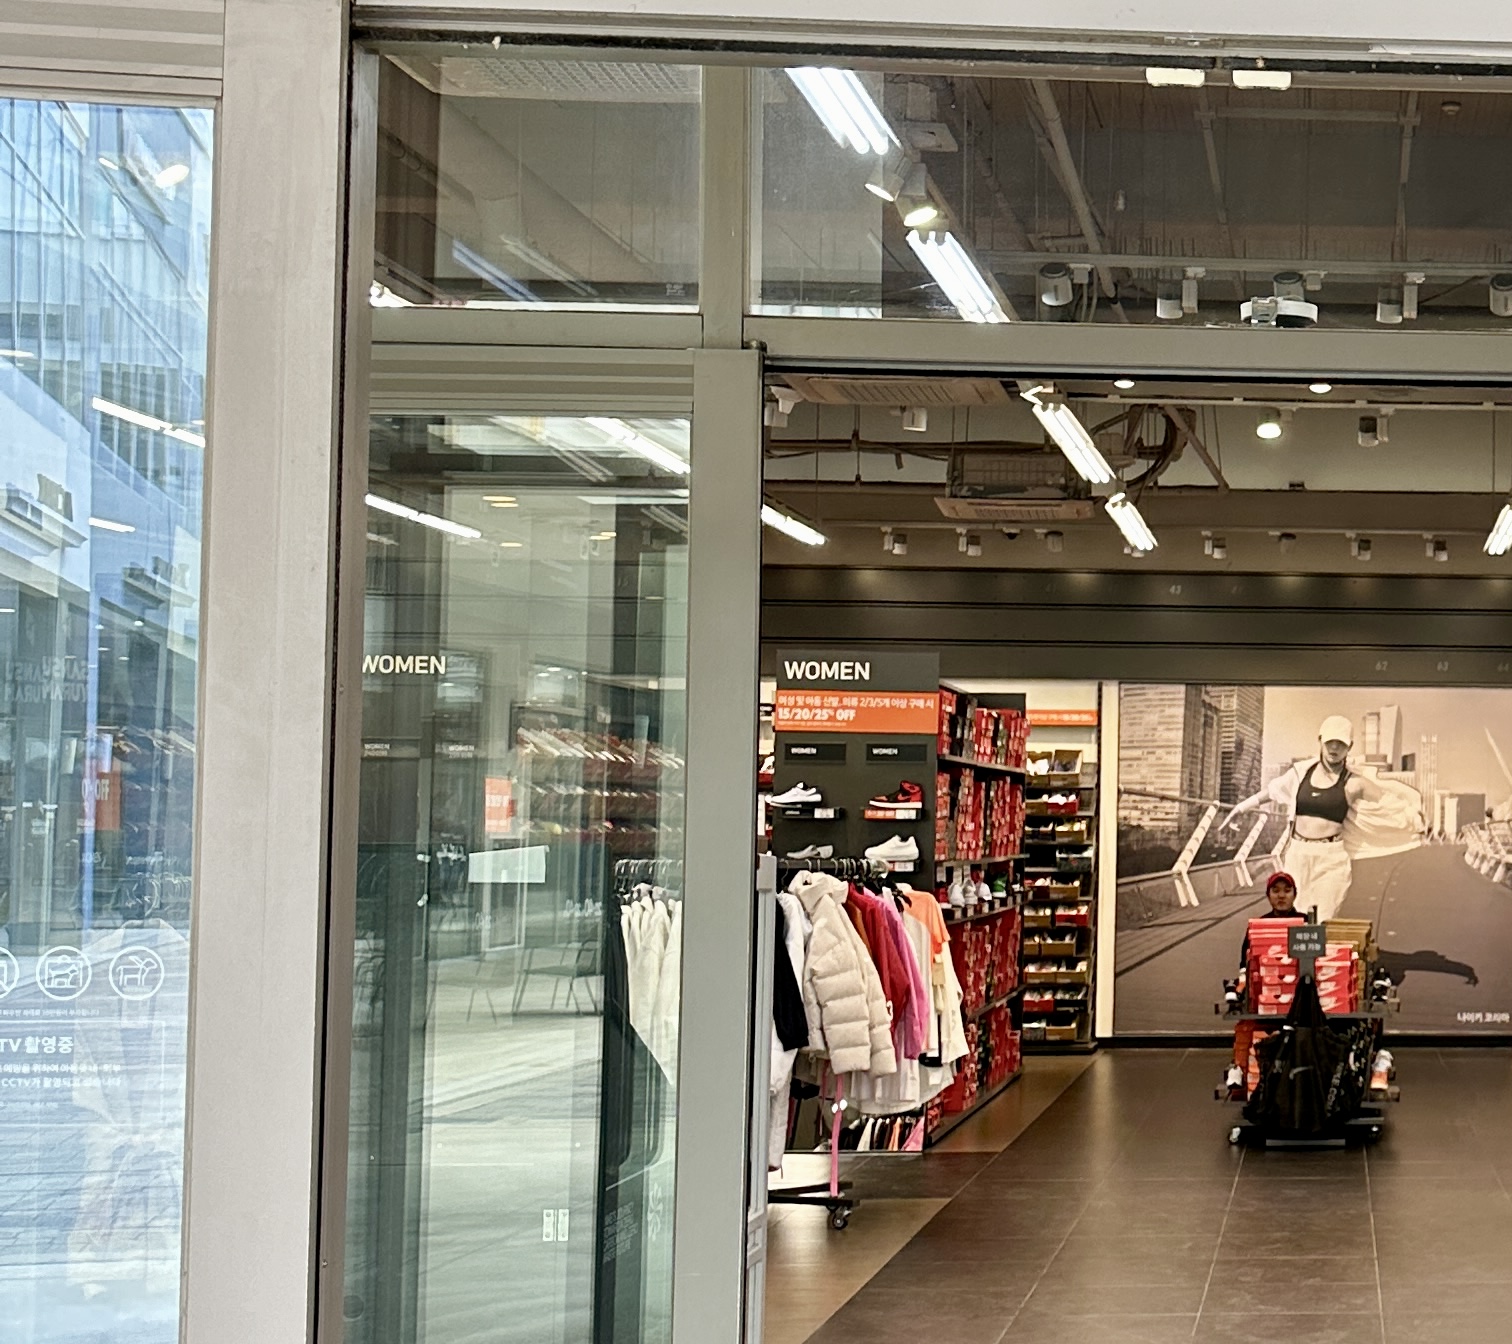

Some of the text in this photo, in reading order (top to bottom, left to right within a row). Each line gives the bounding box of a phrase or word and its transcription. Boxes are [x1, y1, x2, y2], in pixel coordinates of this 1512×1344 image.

[361, 654, 447, 675] WOMEN
[784, 660, 871, 681] WOMEN
[835, 709, 856, 721] OFF
[791, 746, 817, 755] WOMEN
[872, 747, 898, 756] WOMEN
[1456, 1011, 1483, 1024] 나이키
[24, 1035, 74, 1054] 촬영중
[1, 1077, 41, 1089] CCTV가
